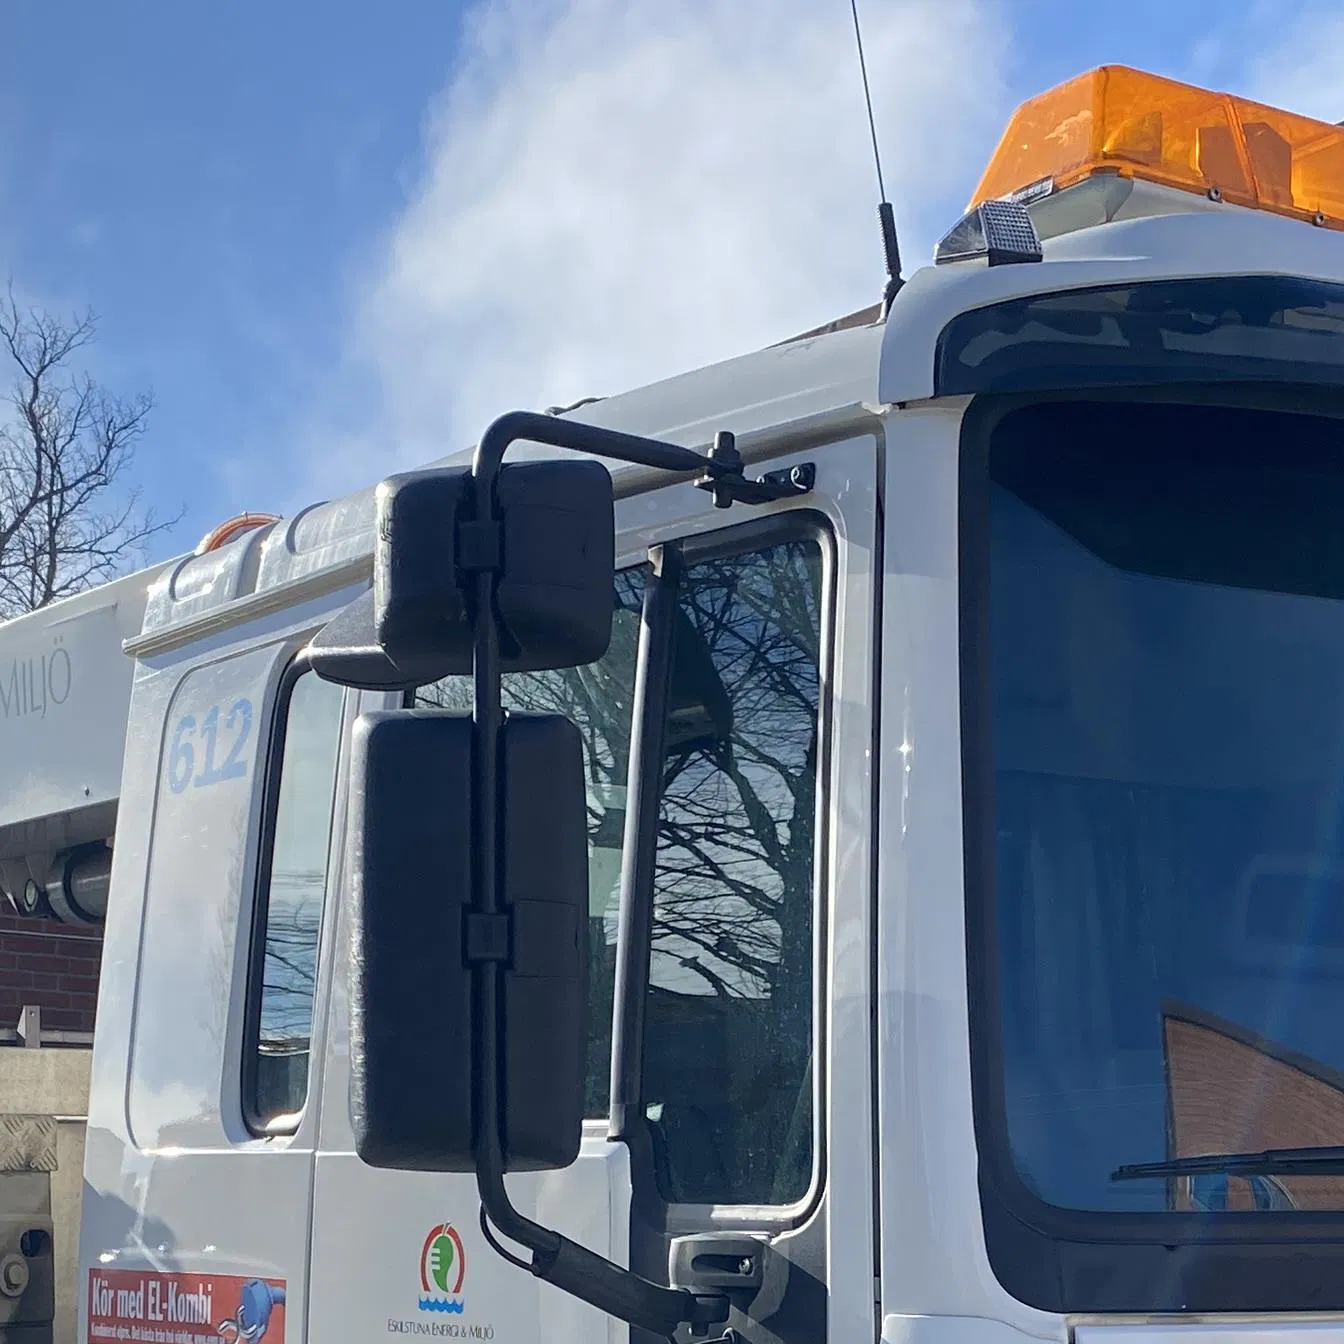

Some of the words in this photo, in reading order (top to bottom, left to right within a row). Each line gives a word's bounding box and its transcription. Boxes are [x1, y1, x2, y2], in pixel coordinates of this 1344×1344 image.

[169, 697, 253, 793] 612
[92, 1277, 114, 1317] Kör
[117, 1279, 144, 1320] med
[147, 1280, 213, 1325] EL-Kombi
[387, 1318, 430, 1336] ESKILSTUNA
[431, 1321, 459, 1338] ENERGI
[460, 1325, 467, 1338] &
[468, 1323, 495, 1341] MILJÖ
